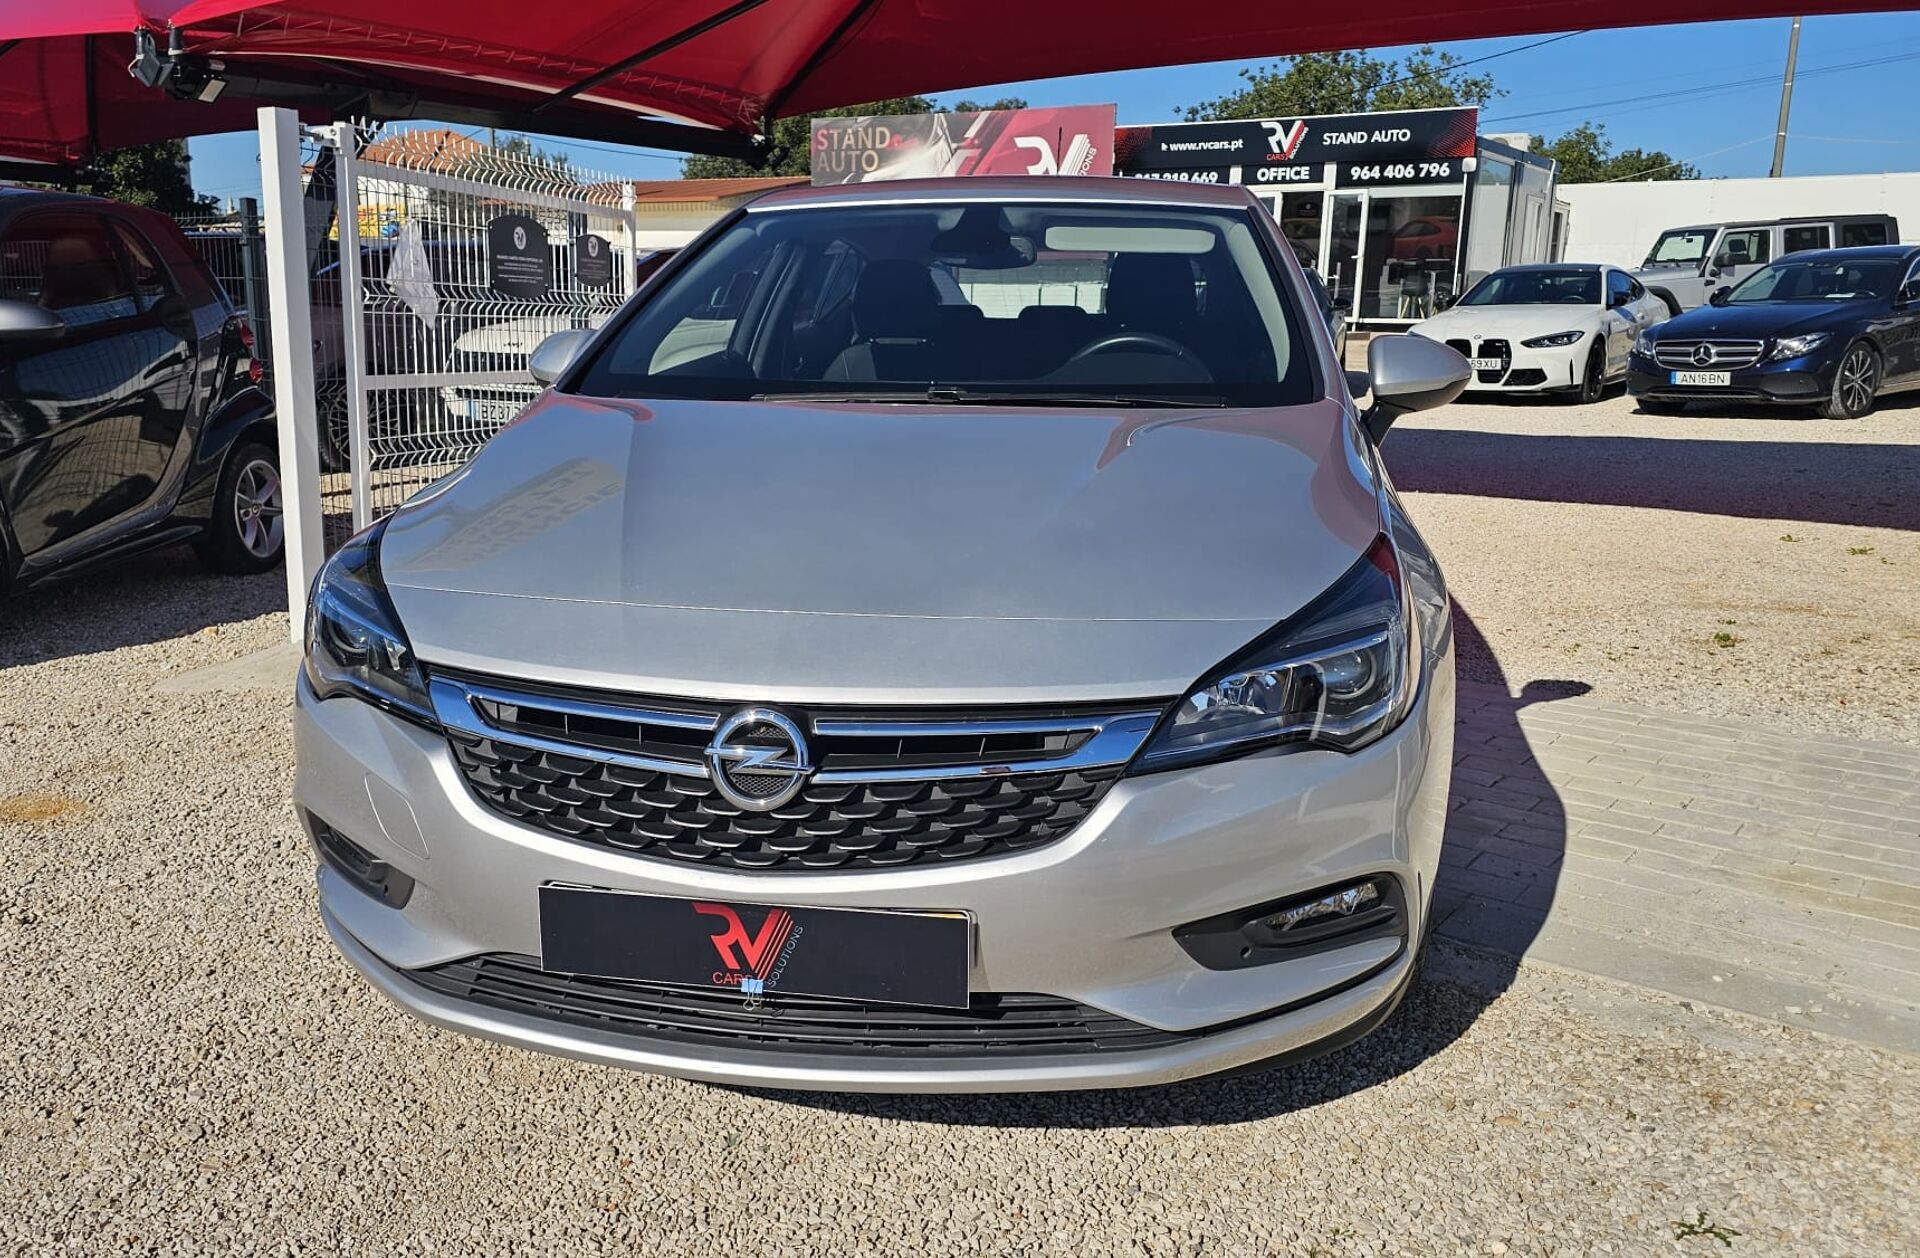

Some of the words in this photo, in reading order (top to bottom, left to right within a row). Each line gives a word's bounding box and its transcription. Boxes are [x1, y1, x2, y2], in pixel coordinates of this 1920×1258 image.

[816, 126, 891, 150] STAND
[1169, 138, 1244, 152] www.rvcars.pt
[1260, 120, 1305, 155] RV
[1322, 131, 1368, 145] STAND
[1370, 129, 1411, 143] AUTO
[816, 149, 879, 172] AUTO
[1191, 171, 1219, 183] 669
[1256, 166, 1310, 182] OFFICE
[1350, 165, 1381, 180] 964
[1383, 163, 1415, 179] 406
[1418, 162, 1450, 178] 796
[691, 901, 793, 977] RV
[767, 924, 804, 988] SOLUTIONS
